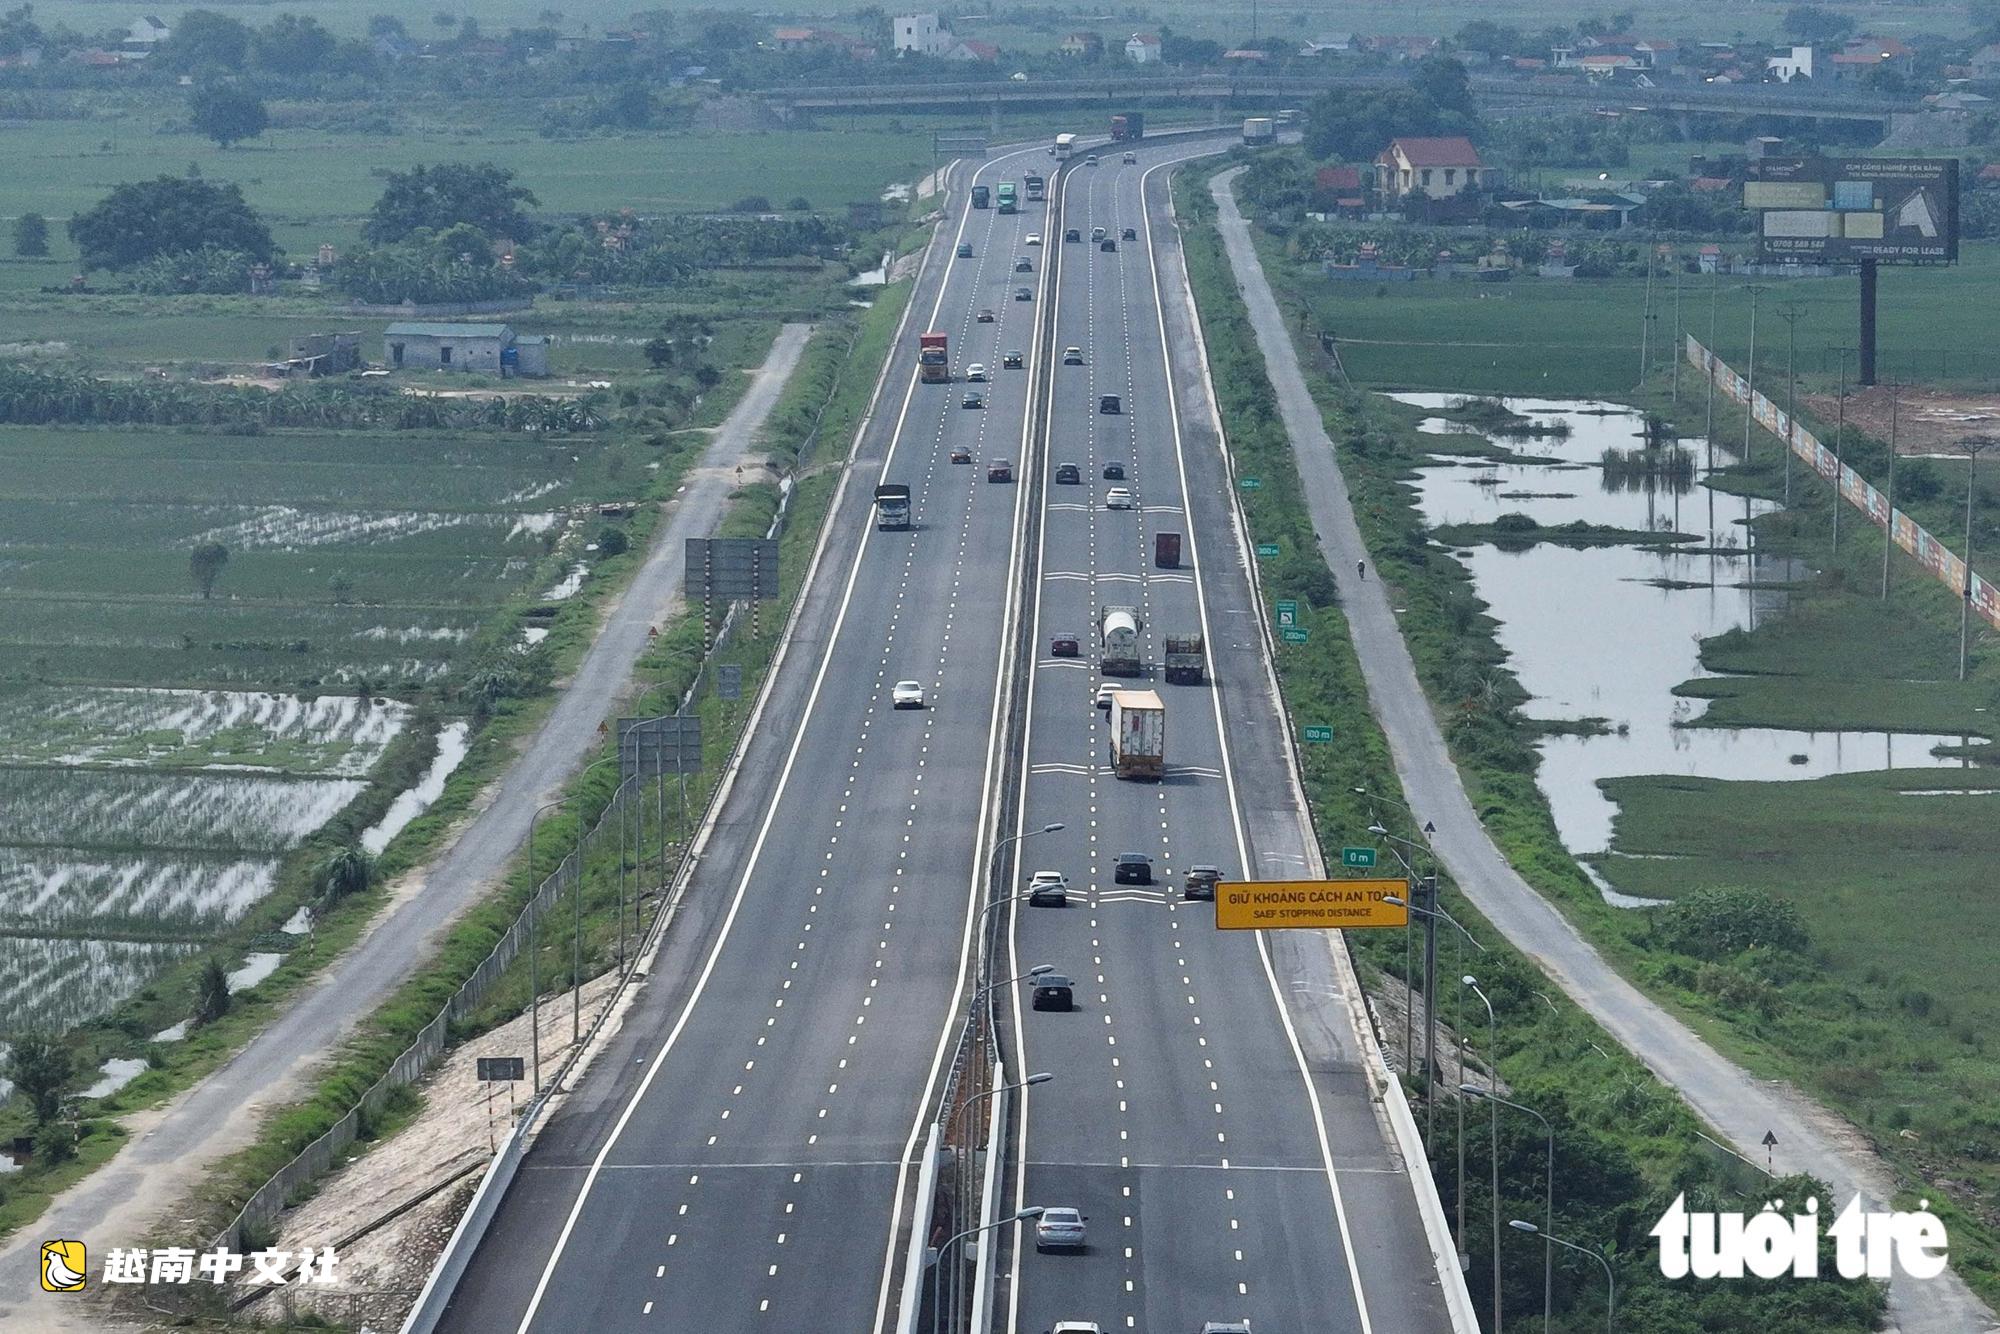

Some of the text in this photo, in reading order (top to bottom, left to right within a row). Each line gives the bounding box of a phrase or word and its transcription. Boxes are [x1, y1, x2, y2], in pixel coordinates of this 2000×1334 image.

[1873, 246, 1900, 255] READY
[1902, 246, 1919, 255] FOR
[1921, 246, 1945, 255] LEASE
[1306, 729, 1330, 740] 100 m
[1350, 852, 1368, 863] 0 m
[1228, 890, 1250, 905] GIỮ
[1254, 888, 1306, 904] KHOẢNG
[1308, 888, 1343, 903] CÁCH
[1345, 891, 1362, 902] AN
[1254, 908, 1372, 918] SAEF STOPPING DISTANCE
